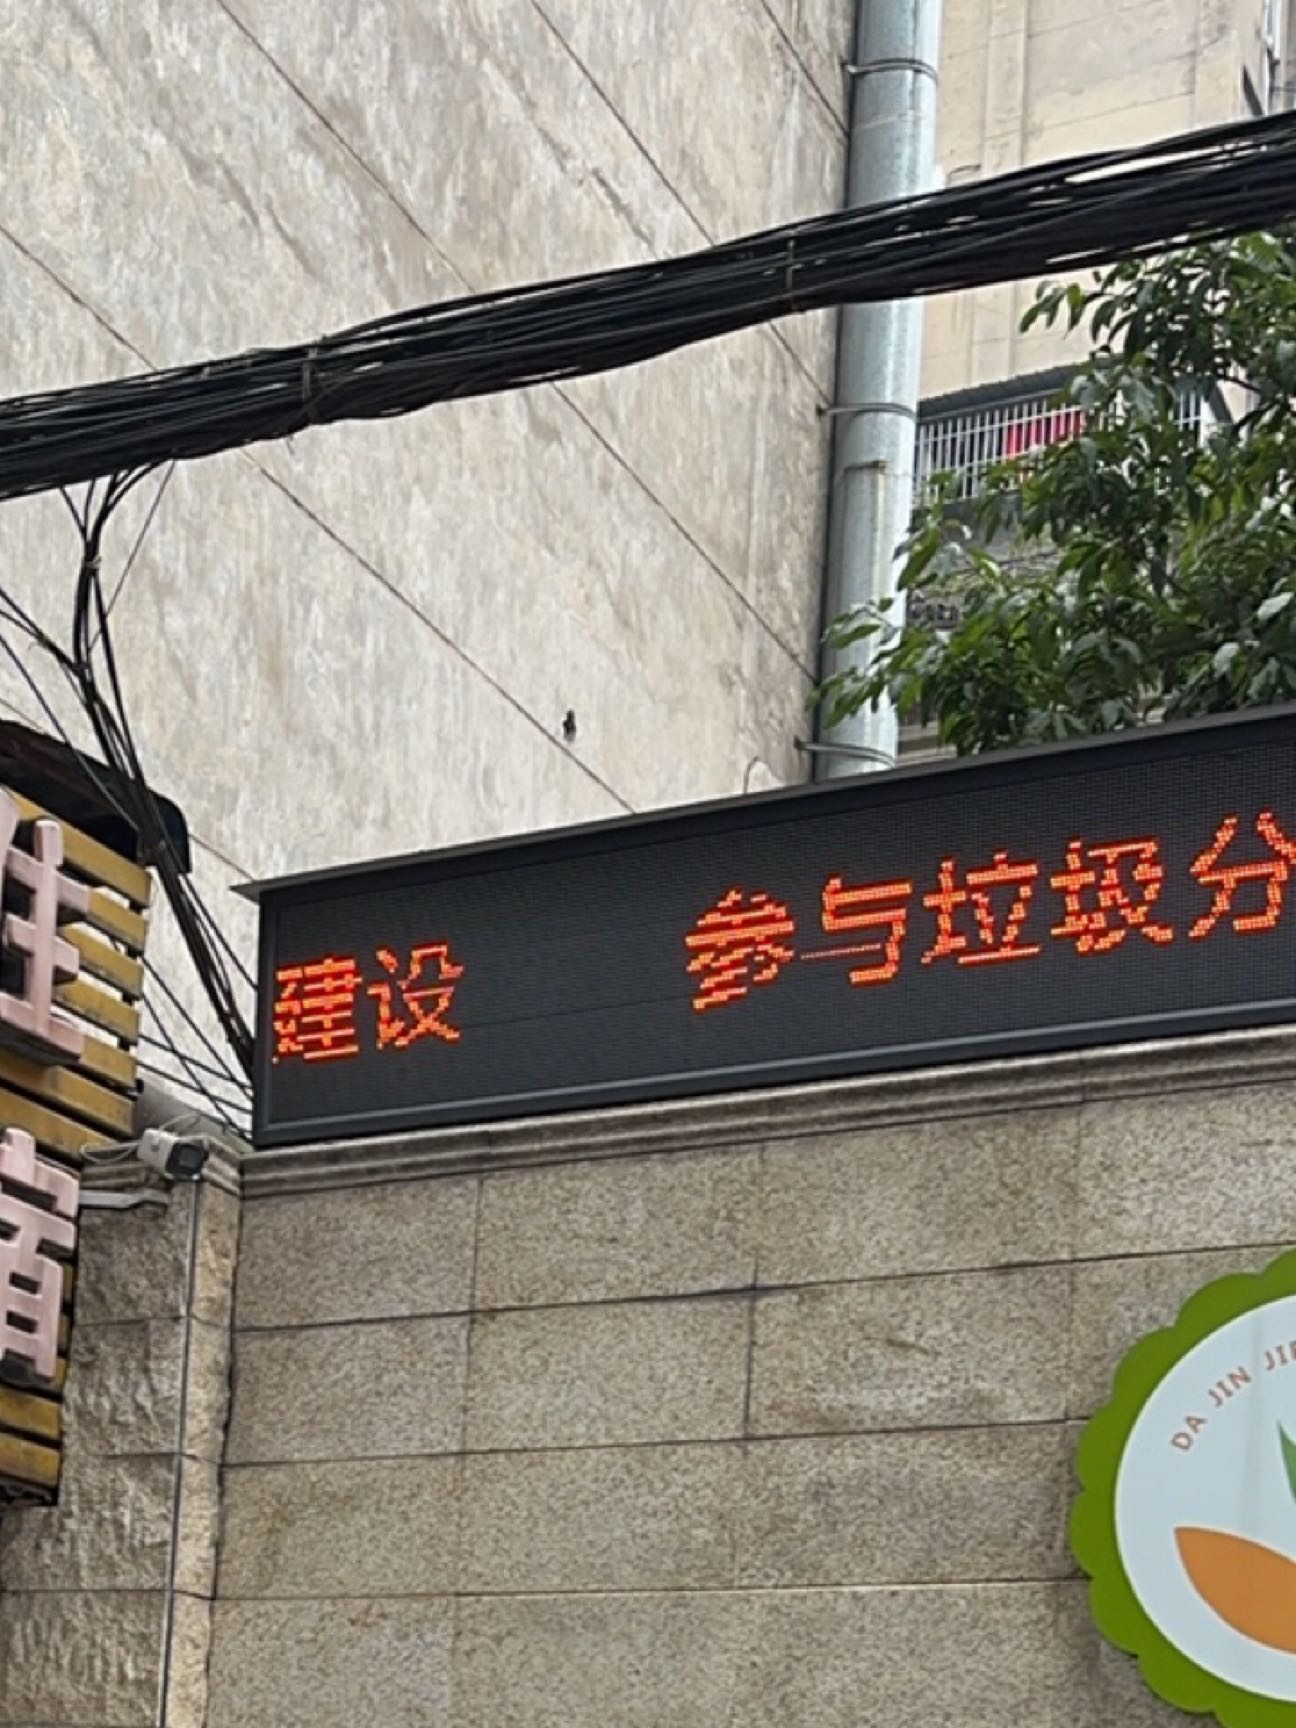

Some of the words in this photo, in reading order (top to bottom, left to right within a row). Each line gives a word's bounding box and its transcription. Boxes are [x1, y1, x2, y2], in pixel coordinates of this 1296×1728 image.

[272, 941, 463, 1064] 建设
[684, 811, 1296, 1010] 参与垃圾分
[1170, 1416, 1207, 1451] DA
[1208, 1366, 1251, 1407] JIN
